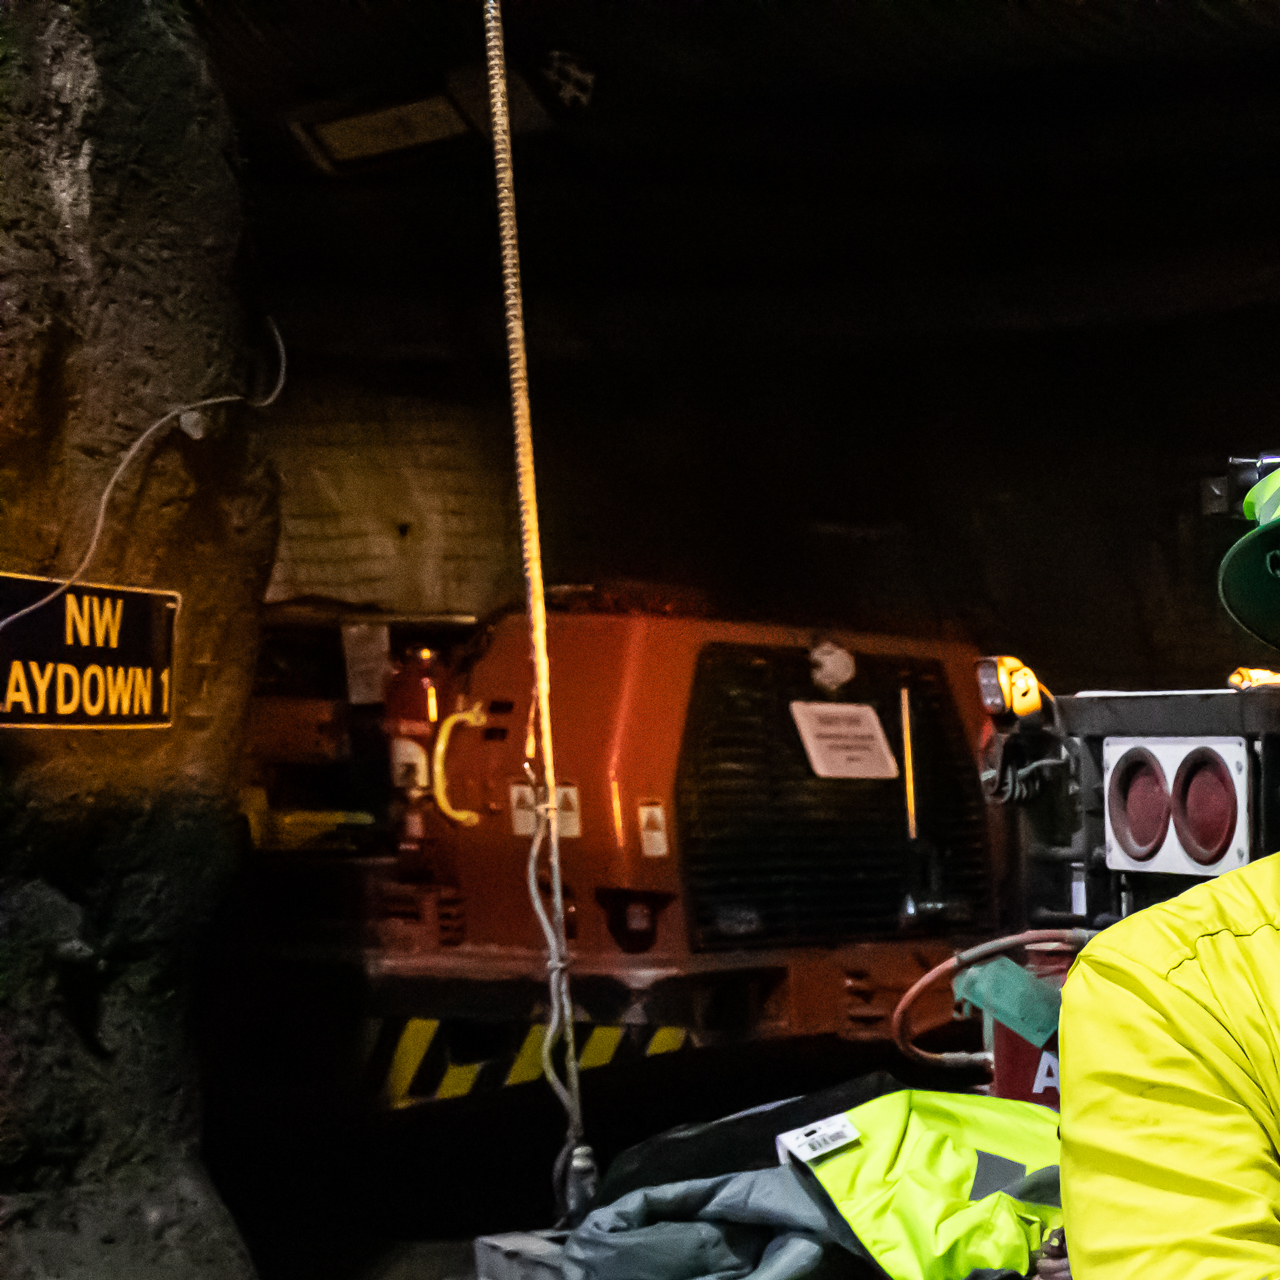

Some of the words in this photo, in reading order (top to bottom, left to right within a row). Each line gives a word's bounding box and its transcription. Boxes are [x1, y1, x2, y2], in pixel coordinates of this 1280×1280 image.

[65, 593, 124, 648] NW
[0, 660, 152, 716] AYDOWN
[160, 667, 170, 715] 1
